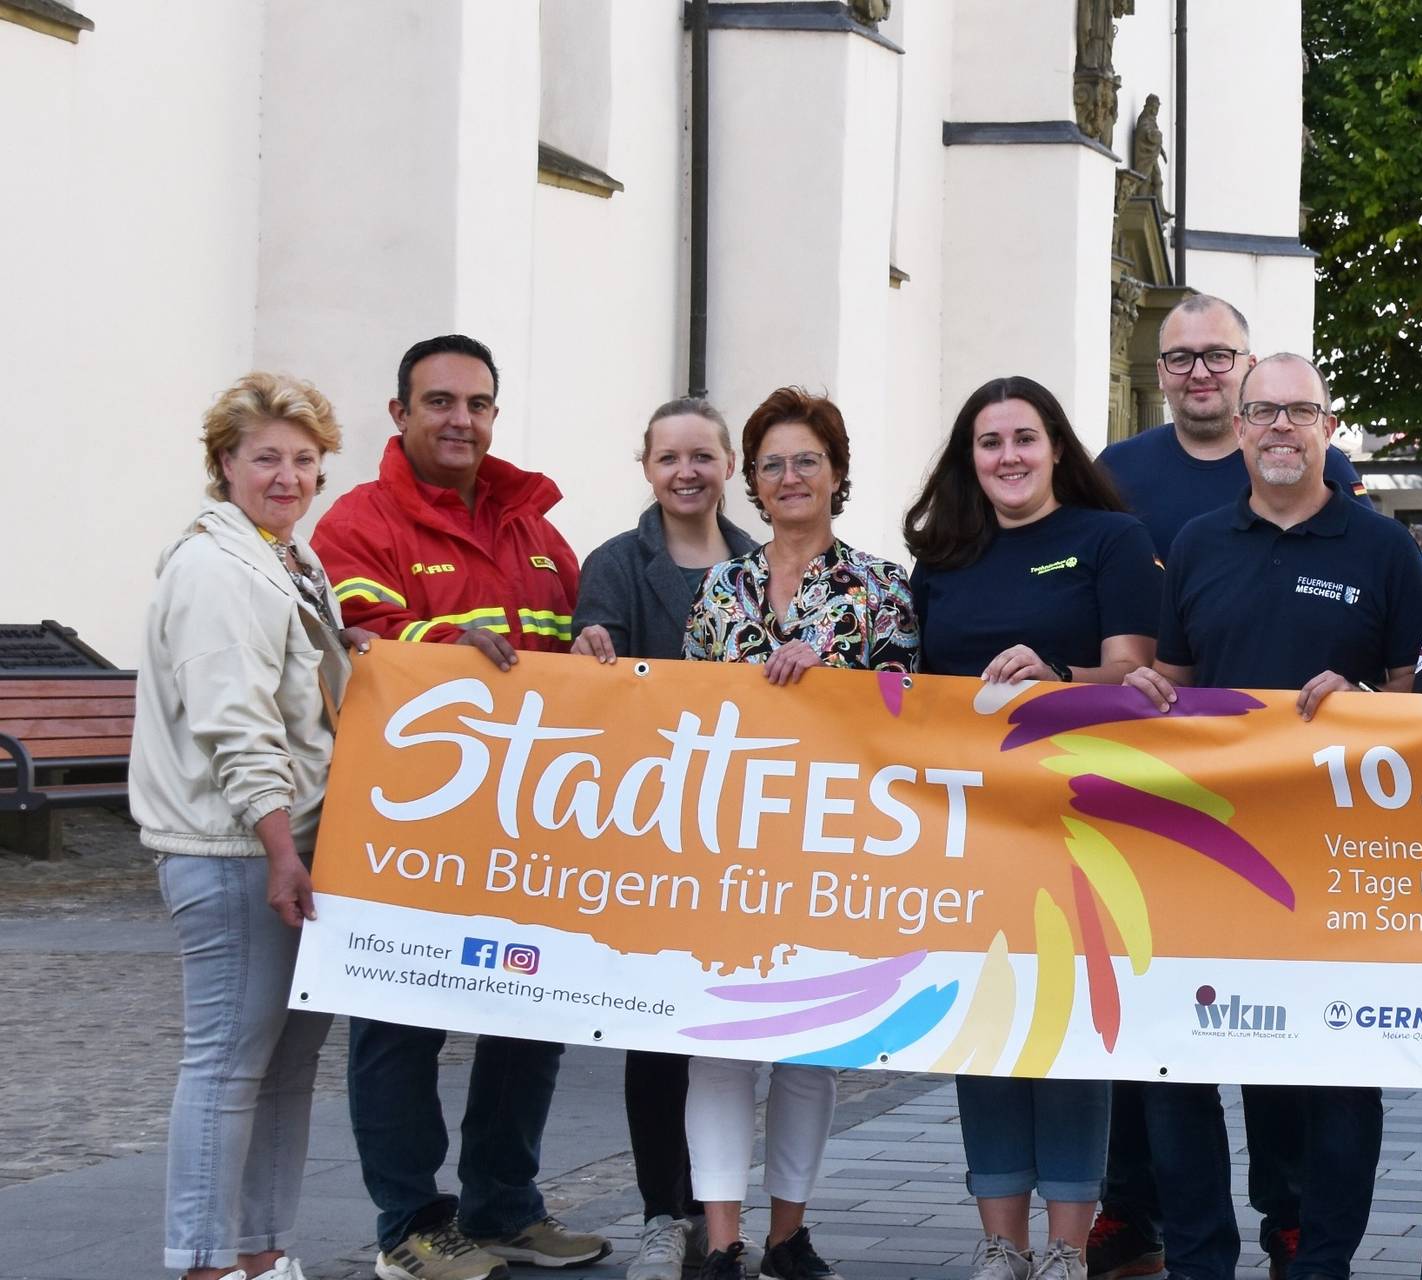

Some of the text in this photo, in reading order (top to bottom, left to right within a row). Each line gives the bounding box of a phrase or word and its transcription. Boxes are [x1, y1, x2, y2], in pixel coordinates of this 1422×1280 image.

[1295, 585, 1342, 600] MESCHEDE
[1297, 576, 1344, 592] FEUERWEHR
[365, 842, 984, 936] von Bürgern für Bürger
[1327, 870, 1342, 894] 2
[1347, 870, 1413, 902] Tage
[1326, 913, 1367, 932] am
[348, 932, 395, 954] Infos
[400, 941, 452, 960] unter
[344, 962, 676, 1017] www.stadtmarketing-meschede.de
[1382, 1031, 1410, 1040] Meine
